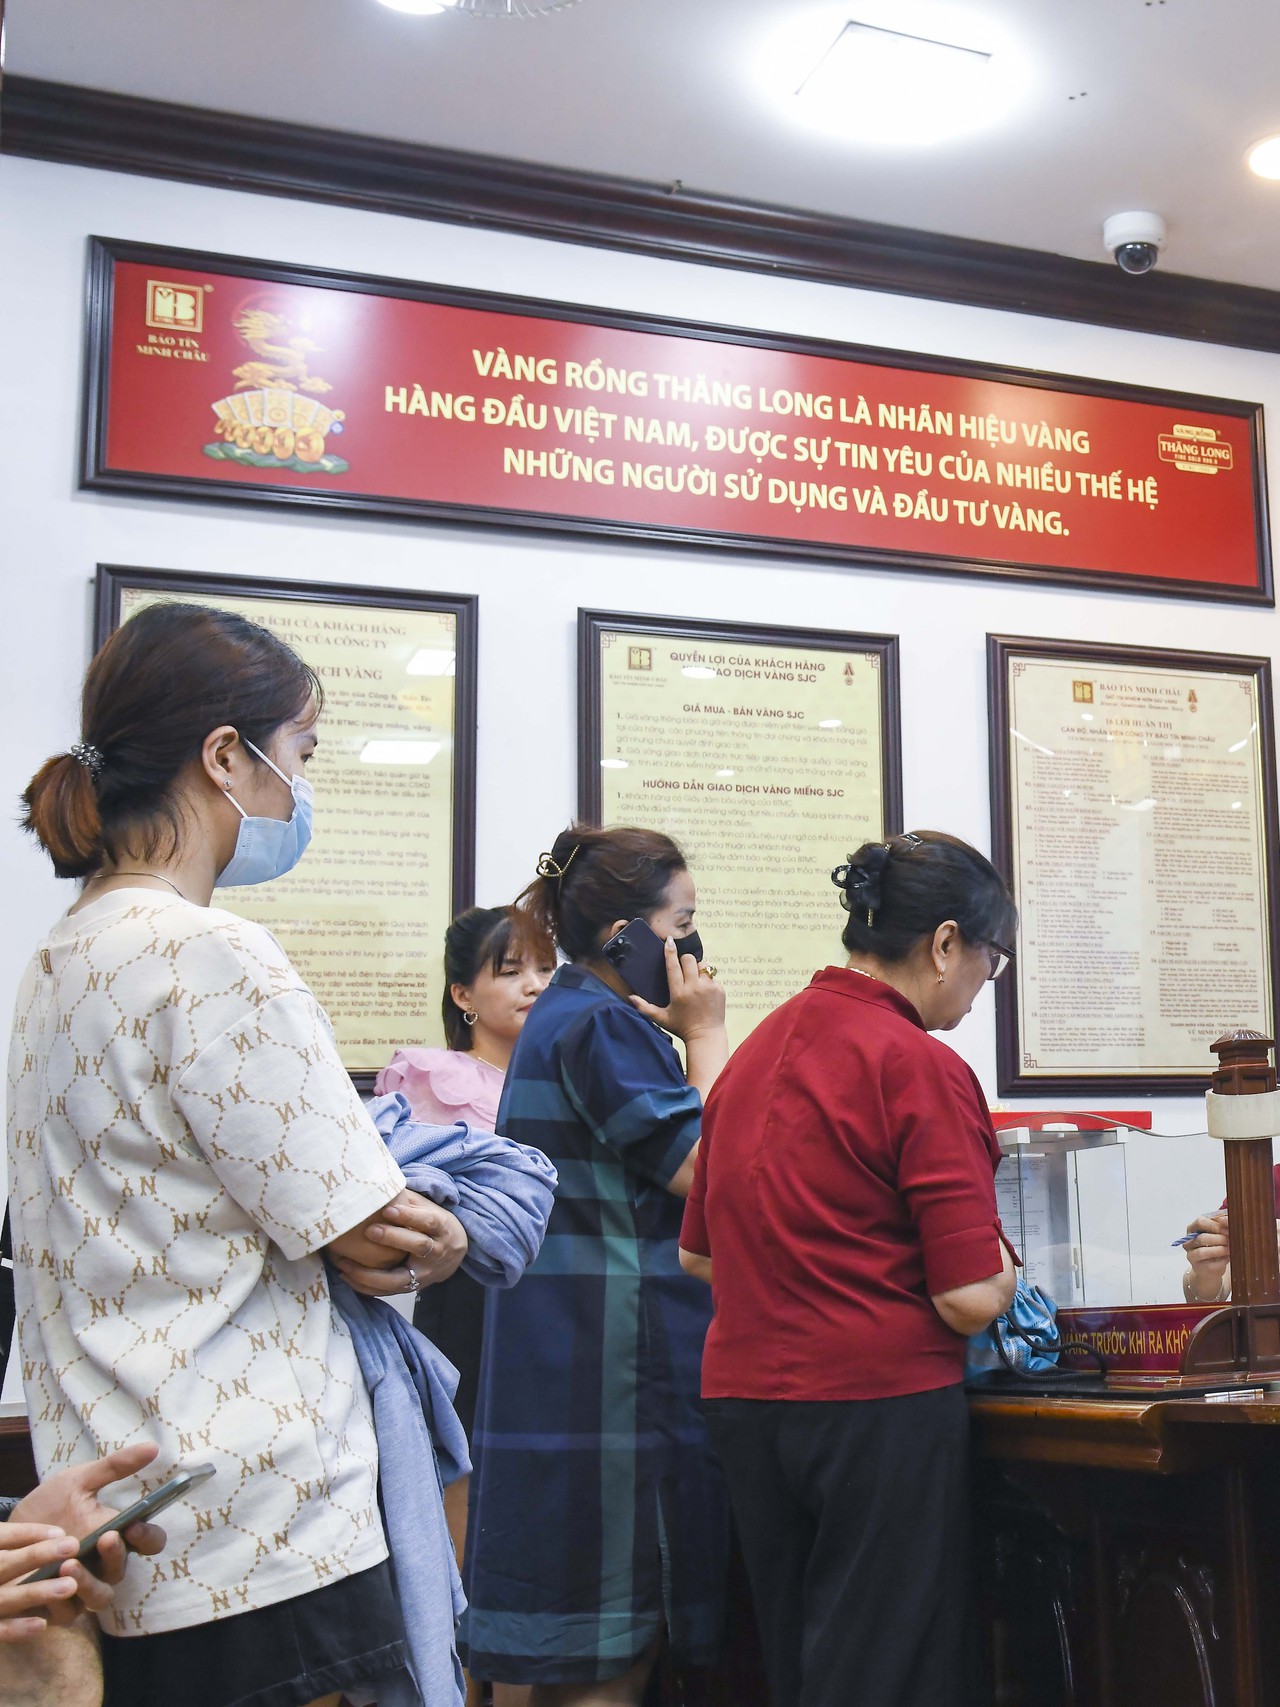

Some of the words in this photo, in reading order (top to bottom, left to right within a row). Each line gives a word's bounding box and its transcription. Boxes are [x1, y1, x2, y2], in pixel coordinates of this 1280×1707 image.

[472, 347, 557, 385] VÀNG
[565, 358, 648, 397] RỒNG
[653, 371, 752, 410] THĂNG
[759, 387, 833, 421] LONG
[839, 395, 873, 426] LÀ
[878, 403, 953, 436] NHÃN
[960, 413, 1017, 448] HIỆU
[1022, 420, 1090, 454] VÀNG
[384, 383, 476, 422] HÀNG
[481, 393, 547, 430] ĐẦU
[553, 405, 618, 444] VIỆT
[624, 416, 699, 452] NAM,
[705, 425, 788, 463] ĐƯỢC
[793, 436, 831, 470] SỰ
[834, 441, 878, 470] TIN
[882, 445, 933, 476] YÊU
[938, 449, 991, 484] CỦA
[996, 461, 1071, 494] NHIỀU
[1075, 470, 1122, 500] THẾ
[1127, 475, 1158, 510] HỆ
[1160, 441, 1198, 455] THĂNG
[1201, 446, 1230, 459] LONG
[503, 447, 615, 485] NHỮNG
[622, 461, 717, 496] NGƯỜI
[723, 468, 763, 501] SỬ
[768, 478, 848, 513] DỤNG
[852, 485, 888, 516] VÀ
[893, 489, 949, 522] ĐẦU
[953, 499, 990, 526] TƯ
[992, 501, 1070, 536] VÀNG.
[323, 619, 368, 633] KHÁCH
[371, 622, 407, 636] HÀNG
[334, 635, 370, 648] CÔNG
[670, 650, 705, 662] QUYỀN
[709, 655, 725, 666] LỢI
[728, 654, 751, 666] CỦA
[754, 657, 792, 669] KHÁCH
[795, 660, 826, 672] HÀNG
[345, 667, 383, 680] VÀNG
[734, 669, 761, 680] DỊCH
[764, 670, 794, 681] VÀNG
[797, 673, 817, 683] SJC
[683, 702, 701, 713] GIÁ
[704, 705, 725, 714] MUA
[733, 706, 753, 716] BÁN
[756, 707, 784, 718] VÀNG
[787, 711, 805, 719] SJC
[642, 778, 680, 789] HƯỚNG
[683, 778, 704, 790] DẪN
[707, 783, 733, 792] GIAO
[735, 784, 760, 795] DỊCH
[762, 784, 791, 795] VÀNG
[794, 785, 824, 797] MIẾNG
[827, 789, 845, 797] SJC
[1091, 1326, 1127, 1355] TRƯỚC
[1129, 1330, 1146, 1354] KHI
[1148, 1330, 1164, 1354] RA
